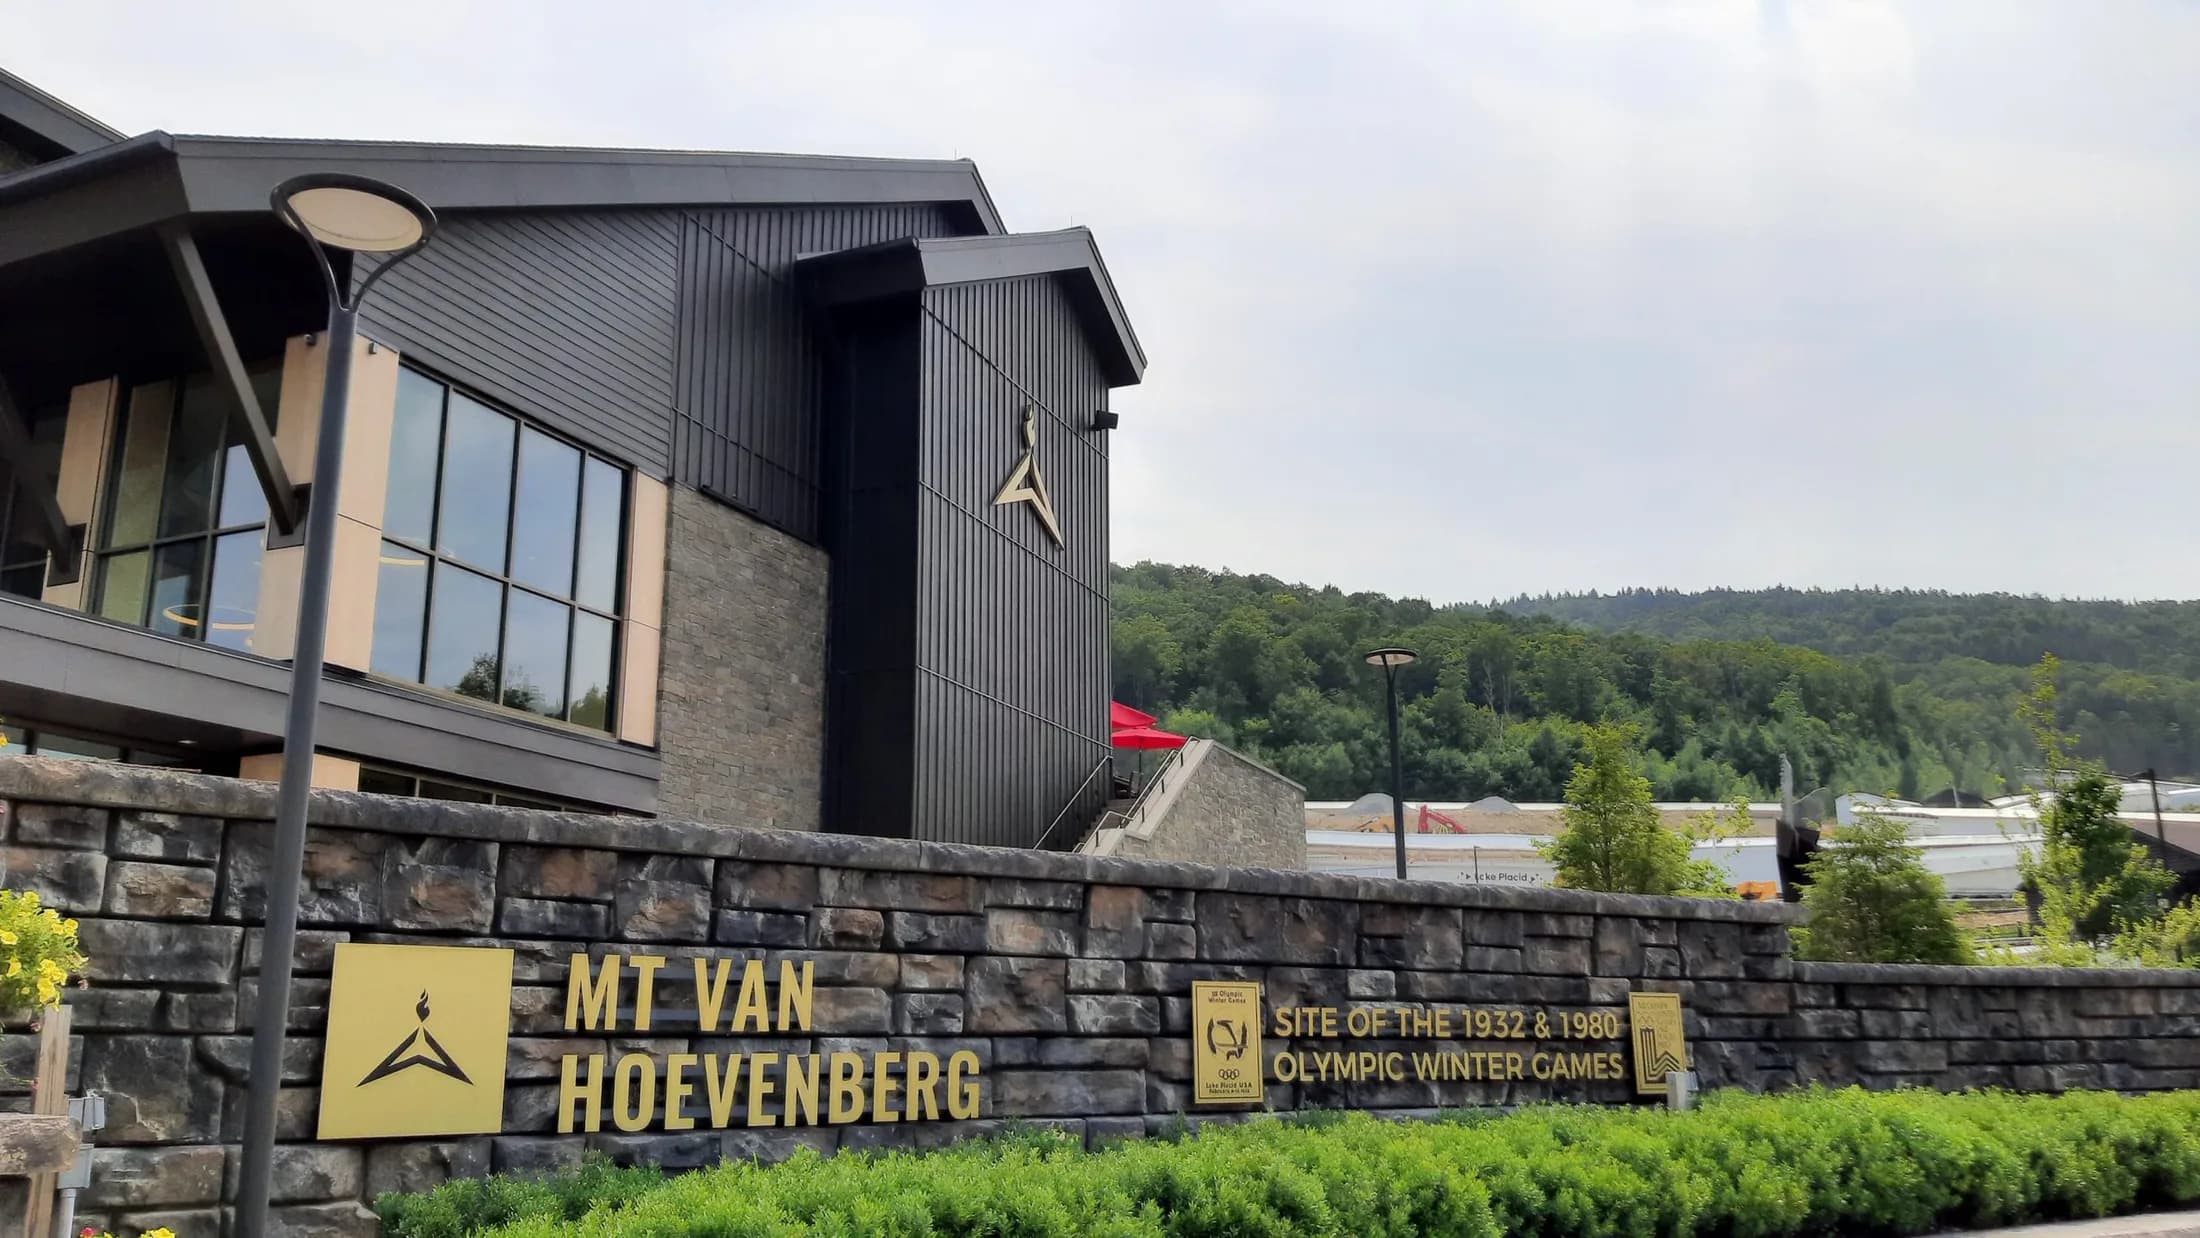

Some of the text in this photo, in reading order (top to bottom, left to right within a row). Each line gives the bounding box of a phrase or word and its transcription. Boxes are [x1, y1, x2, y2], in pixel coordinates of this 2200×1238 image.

[1498, 872, 1528, 882] Placid
[564, 953, 817, 1032] MT VAN
[1274, 1006, 1338, 1037] SITE
[1347, 1007, 1388, 1037] OF
[1396, 1008, 1451, 1038] THE
[1464, 1008, 1526, 1039] 1932
[1534, 1010, 1552, 1040] &
[1560, 1011, 1622, 1039] 1980
[1273, 1051, 1624, 1082] OLYMPIC WINTER GAMES
[557, 1050, 981, 1133] HOEVENBERG
